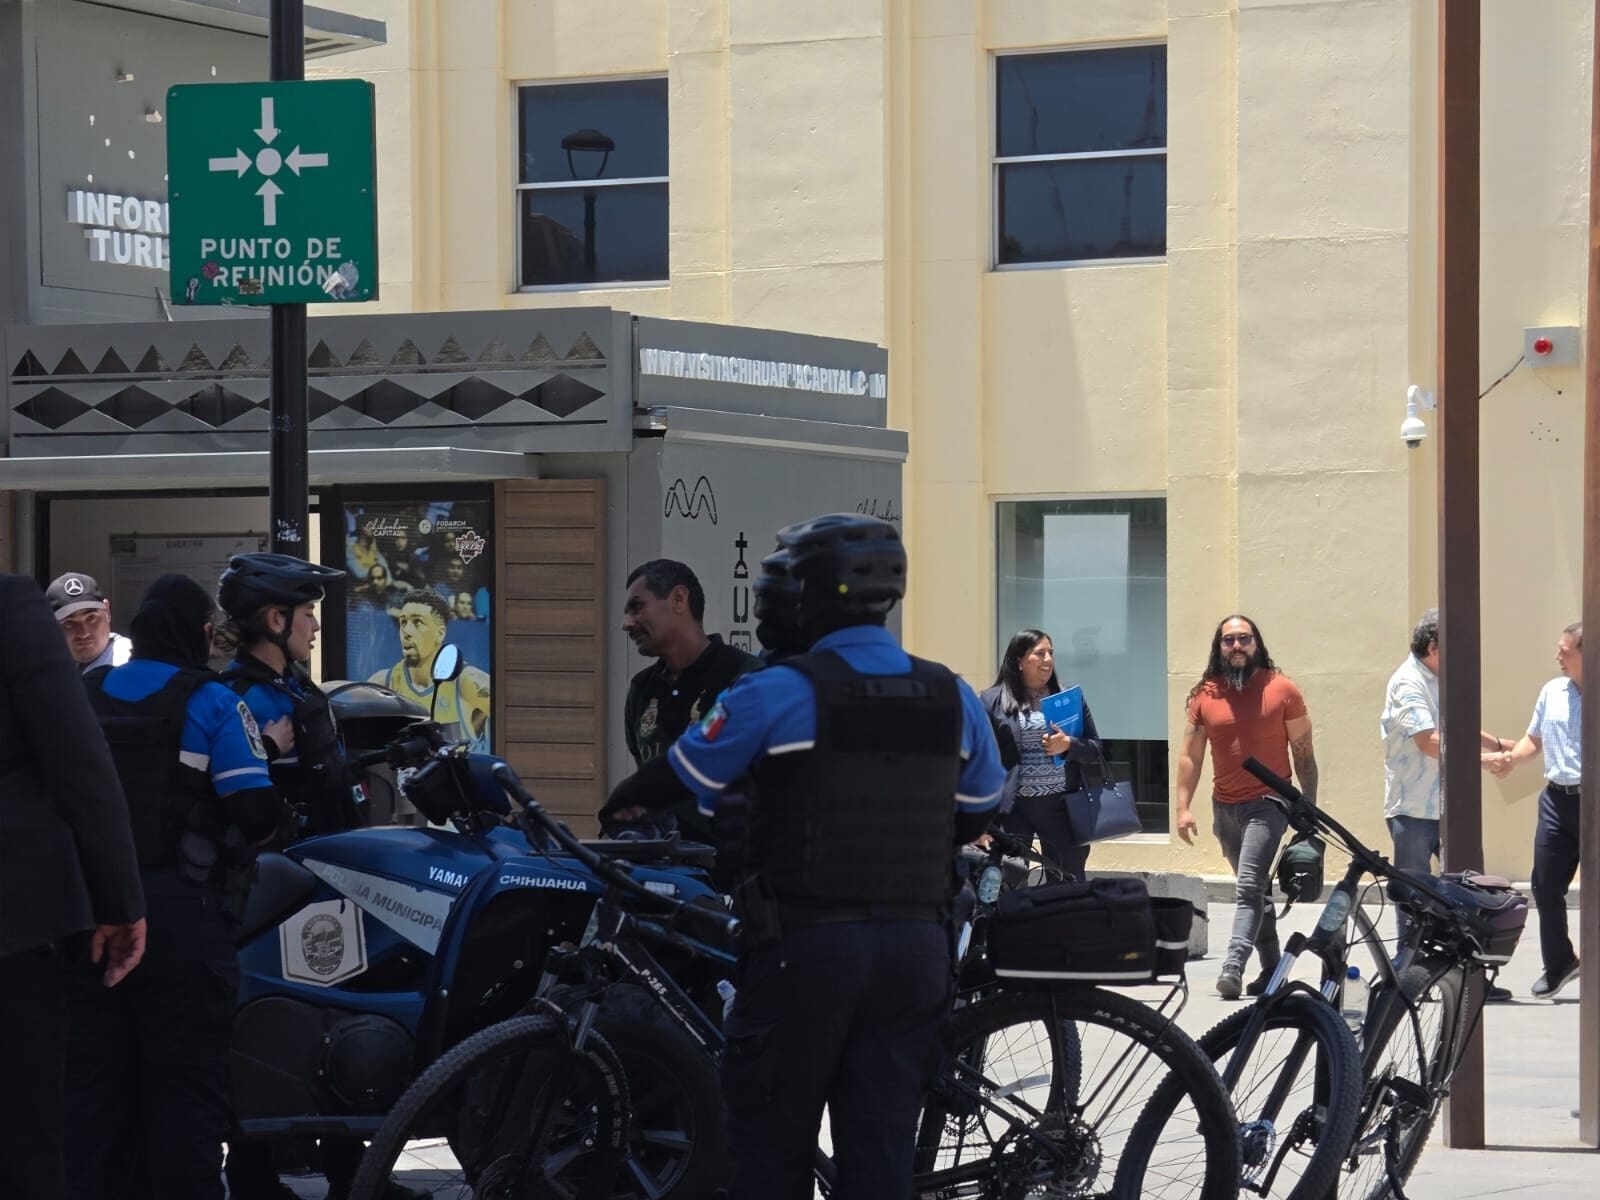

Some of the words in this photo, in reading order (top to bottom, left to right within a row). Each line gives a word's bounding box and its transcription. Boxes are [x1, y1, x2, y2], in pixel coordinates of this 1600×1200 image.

[69, 190, 169, 234] INFOR
[201, 238, 291, 259] PUNTO
[307, 237, 342, 258] DE
[213, 260, 334, 287] REUNIÓN
[373, 529, 401, 537] CAPITAL
[500, 875, 588, 891] CHIHUAHUA
[372, 892, 442, 931] MUNICIPA
